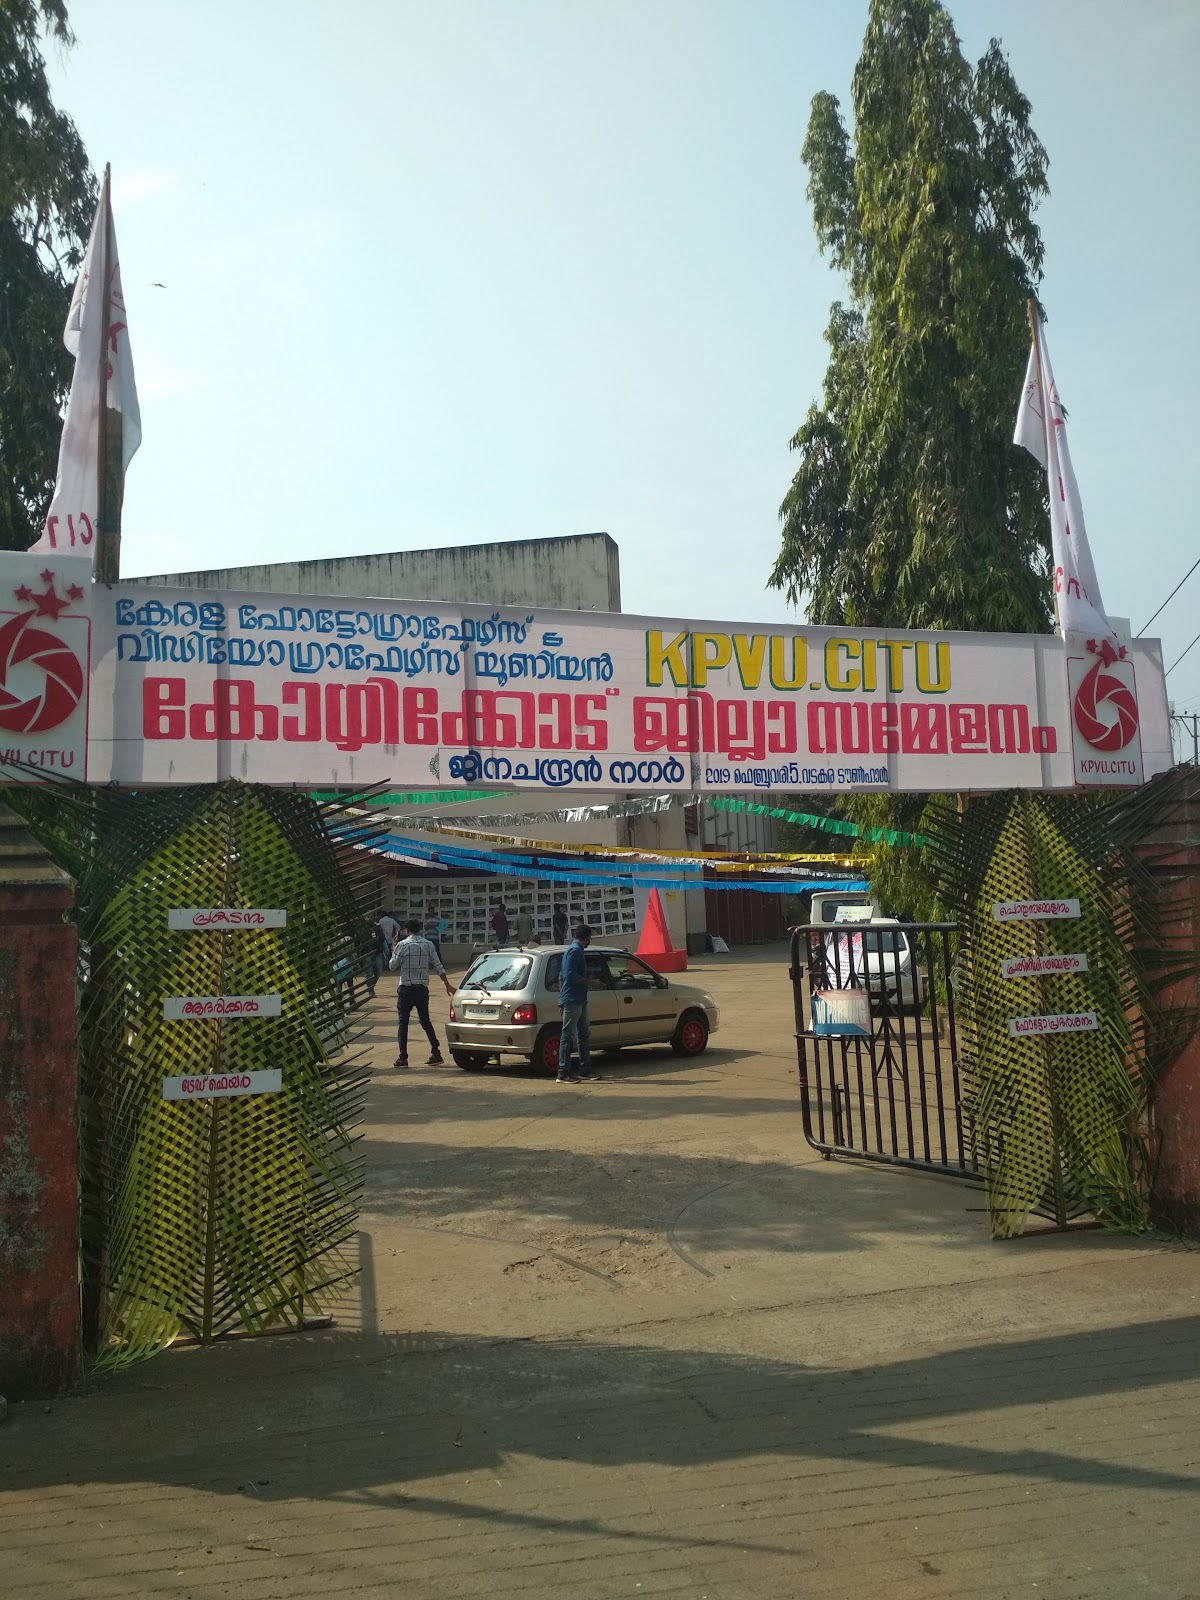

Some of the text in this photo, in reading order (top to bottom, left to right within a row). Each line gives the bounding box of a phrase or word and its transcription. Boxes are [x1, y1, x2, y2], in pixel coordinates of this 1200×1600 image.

[115, 599, 226, 632] കേരള
[238, 604, 534, 647] ഫോട്ടോഗ്രാഫേഴ്സ്
[645, 629, 951, 692] KPVU.CITU
[143, 677, 620, 752] കോഴിക്കോട്
[449, 750, 685, 787] ജിനചന്ദ്രൻ നഗർ
[706, 768, 731, 784] 2019
[192, 911, 265, 926] പ്രകടനം
[182, 998, 259, 1016] ആദരിക്കൽ
